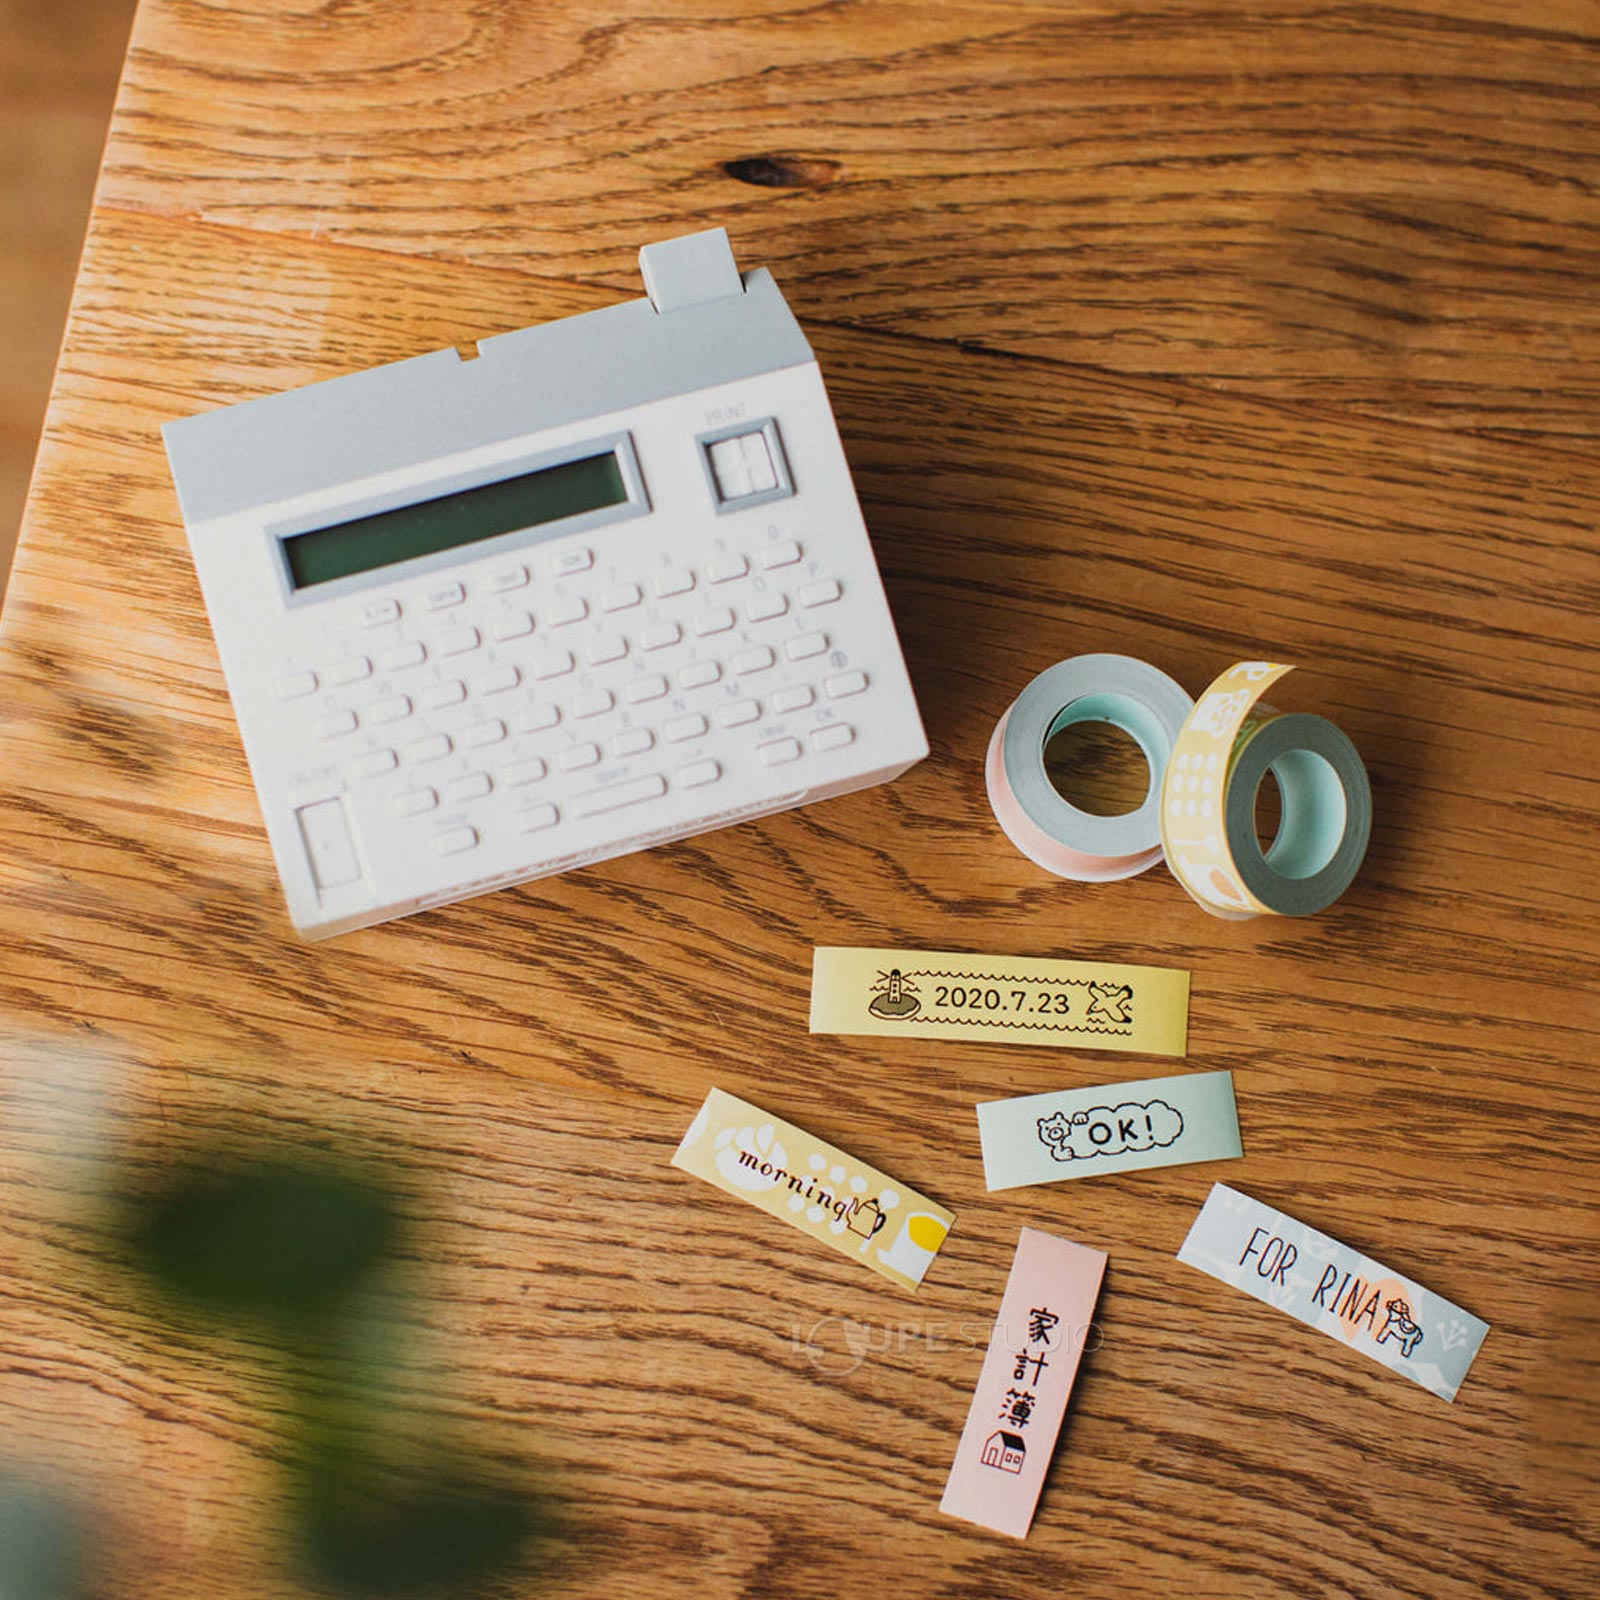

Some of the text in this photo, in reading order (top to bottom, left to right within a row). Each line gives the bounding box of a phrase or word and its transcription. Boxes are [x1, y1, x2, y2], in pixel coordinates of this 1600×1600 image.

[935, 985, 1070, 1015] 2020.7.23
[1088, 1114, 1154, 1145] OK!
[738, 1150, 848, 1222] morning
[1239, 1226, 1382, 1331] FOR RINA
[998, 1306, 1060, 1429] 家計簿
